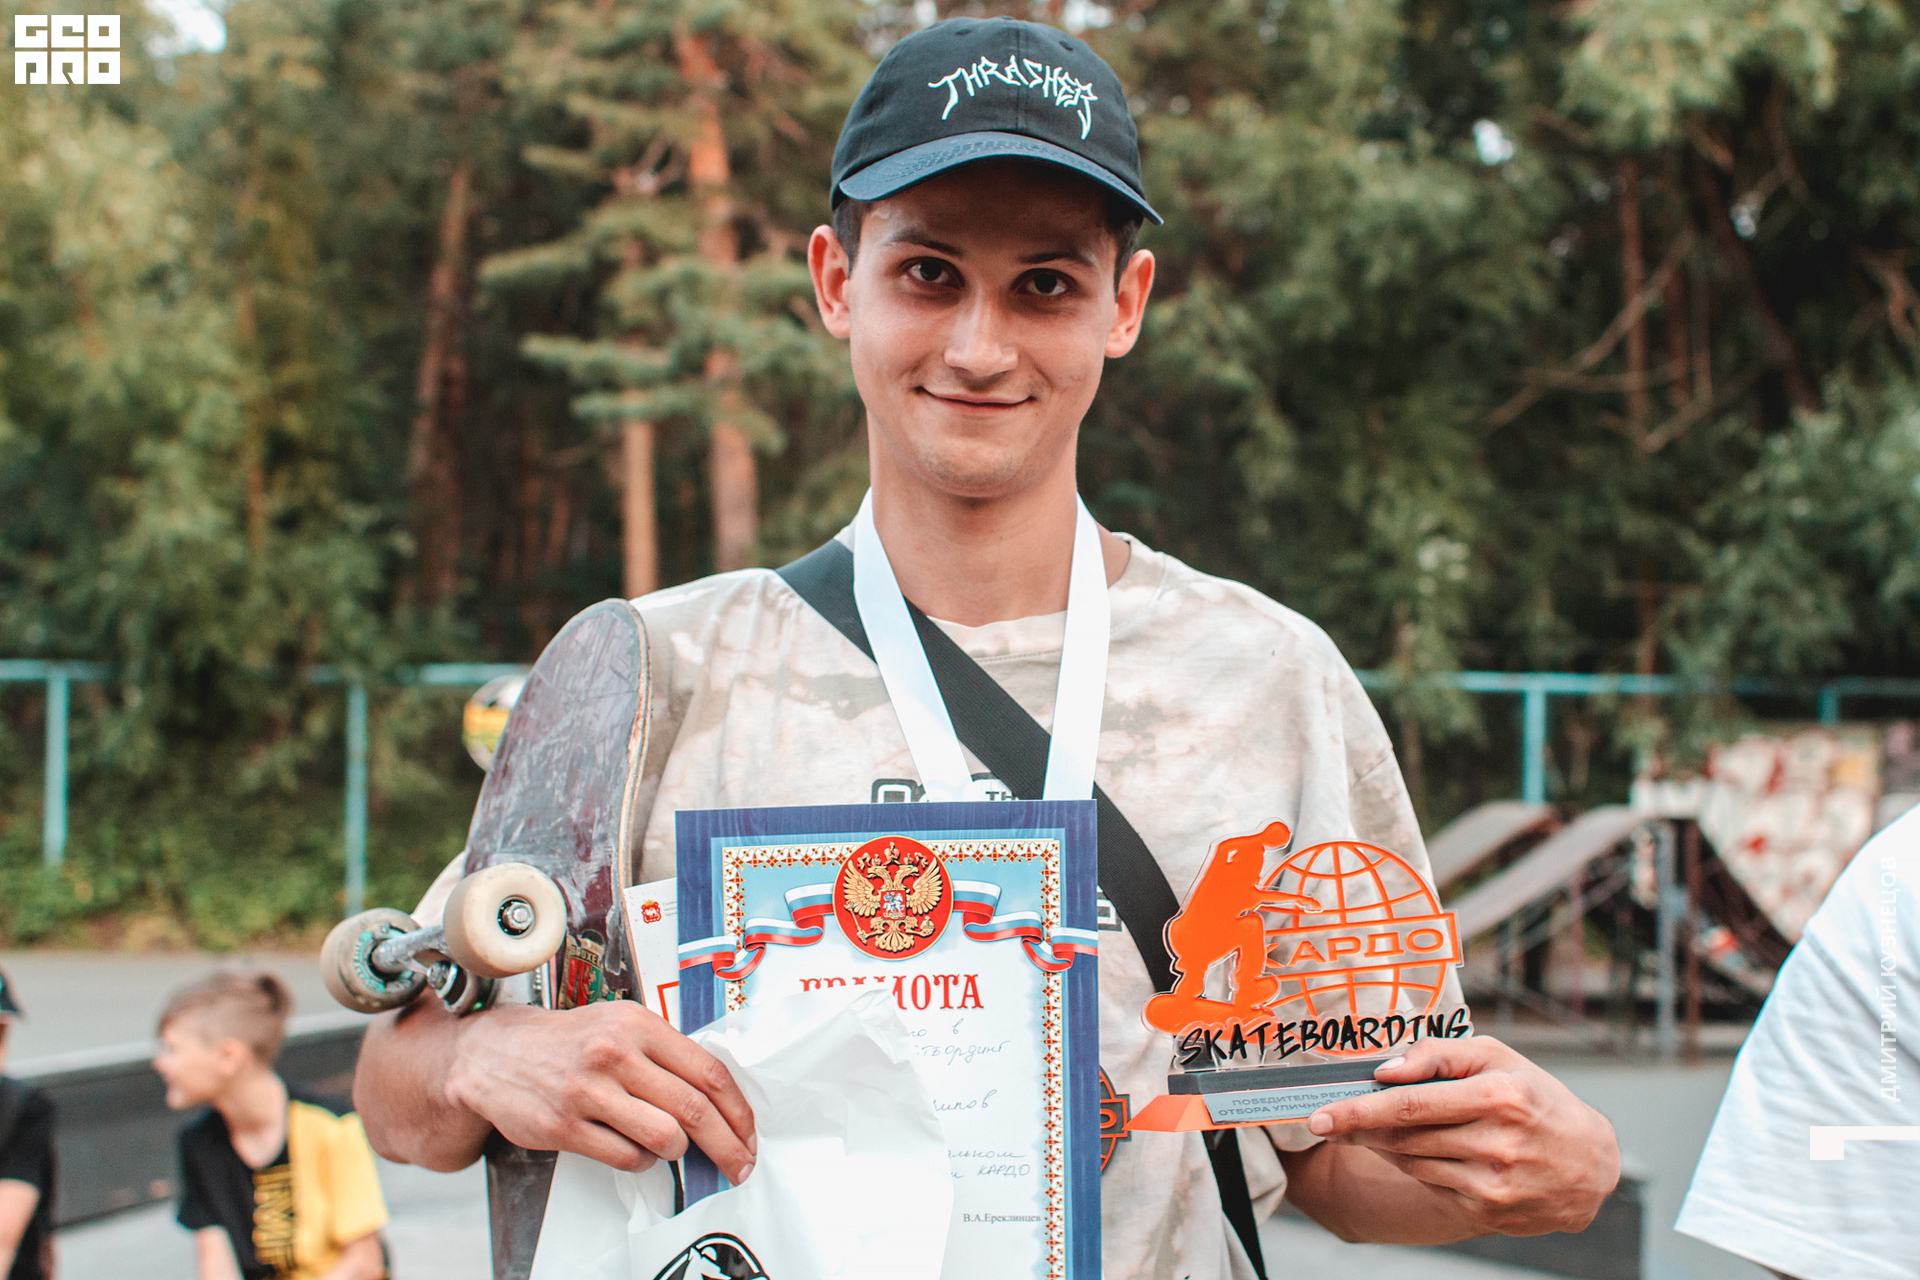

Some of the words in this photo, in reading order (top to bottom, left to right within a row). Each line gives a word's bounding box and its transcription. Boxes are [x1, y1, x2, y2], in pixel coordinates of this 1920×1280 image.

[928, 55, 1098, 139] THRASHER
[1180, 1008, 1470, 1065] SKATEBOARDING
[1218, 1106, 1269, 1116] ОТБОРА
[1232, 1094, 1319, 1106] ПОБЕДИТЕЛЬ
